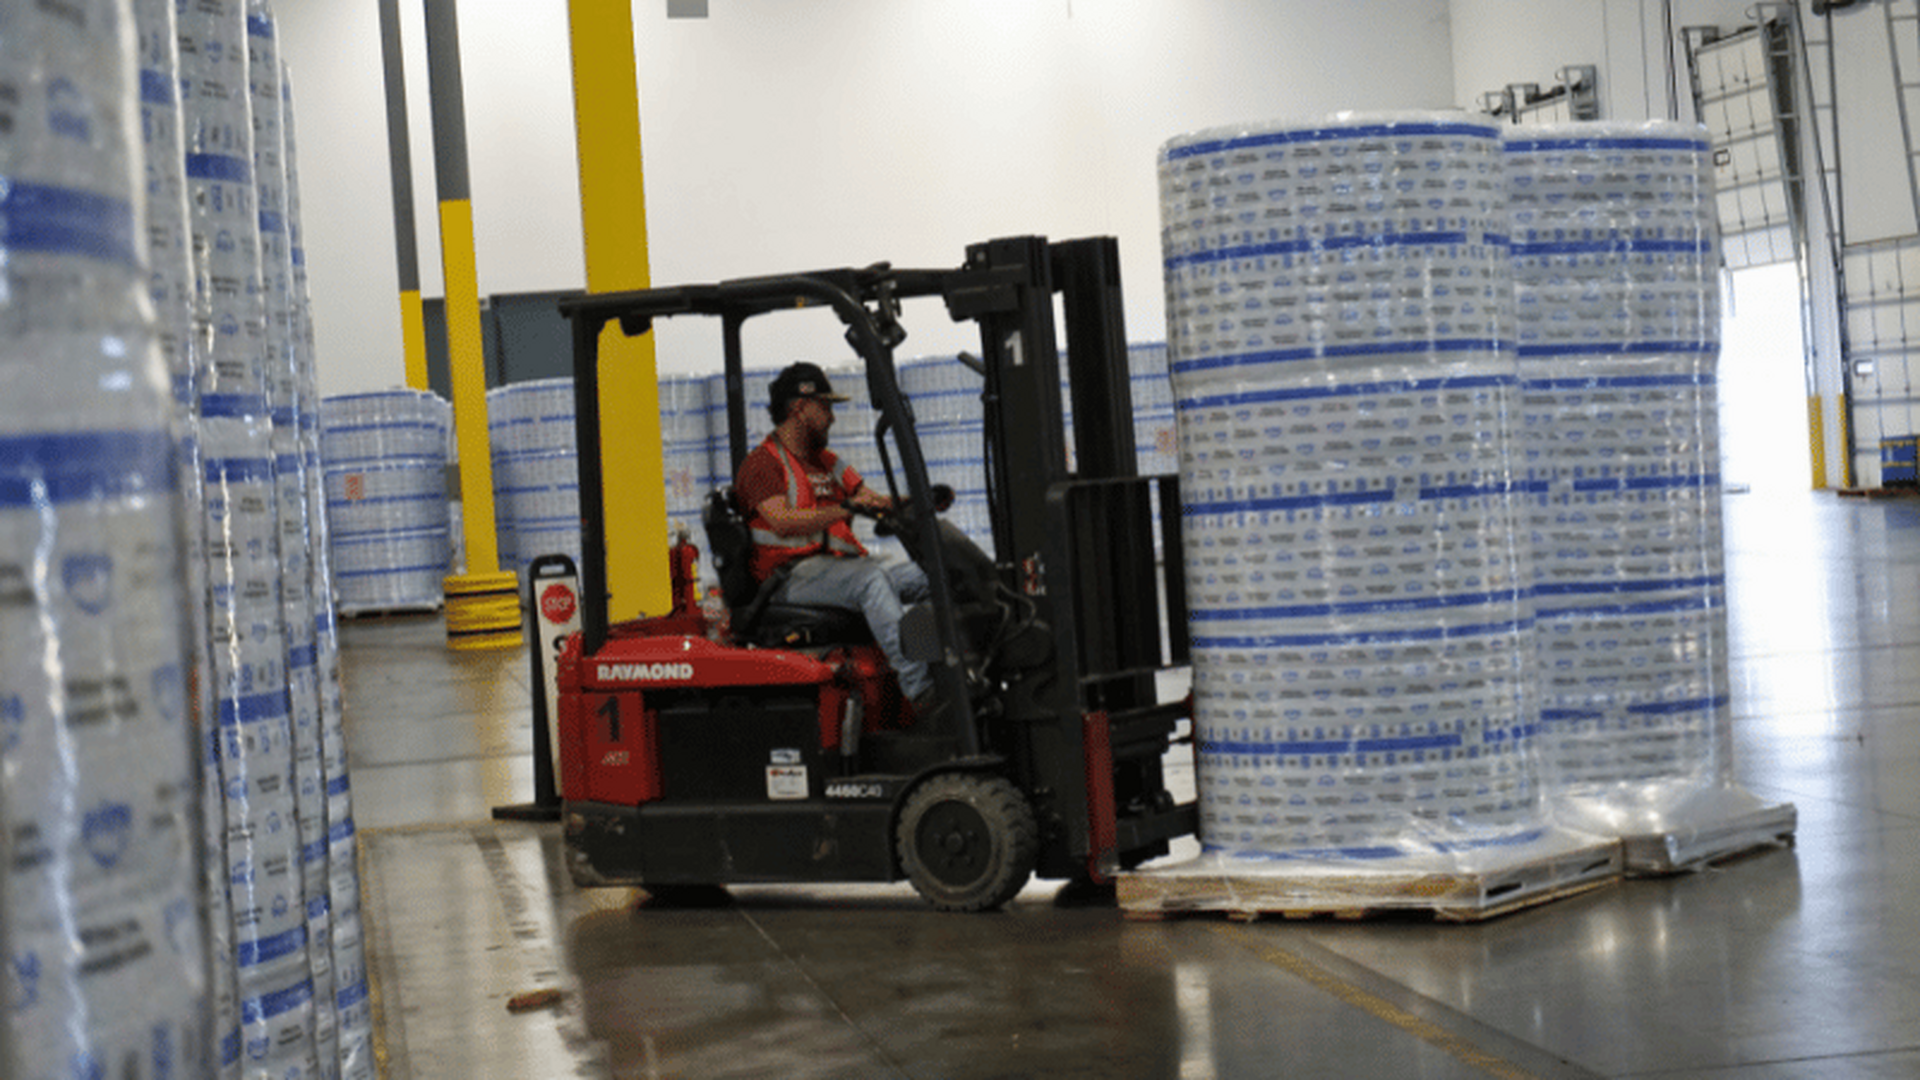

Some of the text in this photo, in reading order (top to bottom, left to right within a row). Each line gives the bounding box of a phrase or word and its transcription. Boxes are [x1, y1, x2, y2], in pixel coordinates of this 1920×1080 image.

[1005, 331, 1023, 366] 1
[597, 663, 693, 681] RAYMOND
[598, 696, 620, 742] 1
